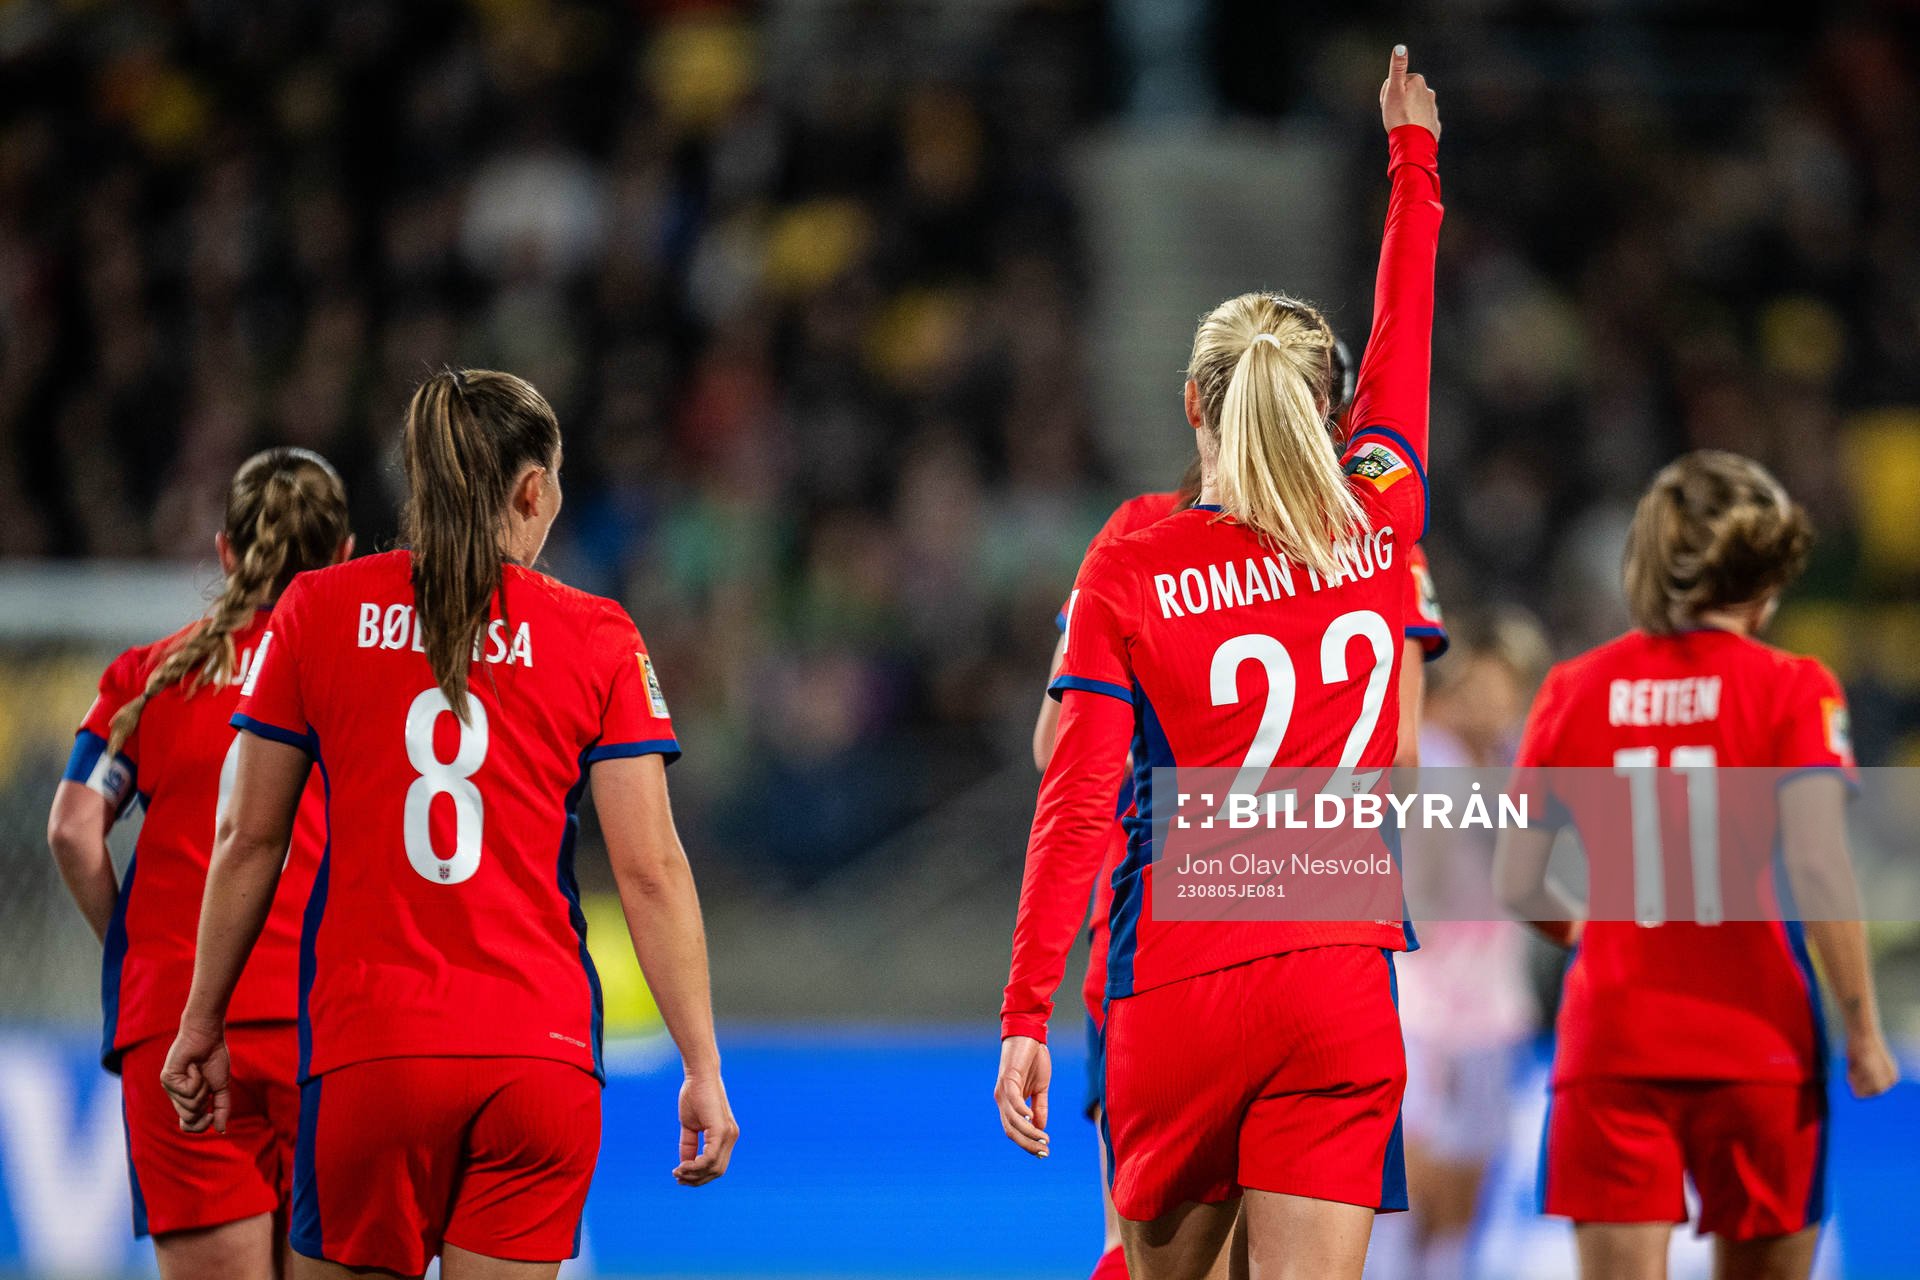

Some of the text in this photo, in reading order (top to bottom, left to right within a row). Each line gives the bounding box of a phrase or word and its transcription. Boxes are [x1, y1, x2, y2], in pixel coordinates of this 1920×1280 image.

[1153, 552, 1296, 619] ROMAN
[403, 687, 489, 885] 8
[1209, 609, 1395, 821] 22
[1608, 675, 1722, 727] REITEN
[1613, 745, 1724, 928] 11
